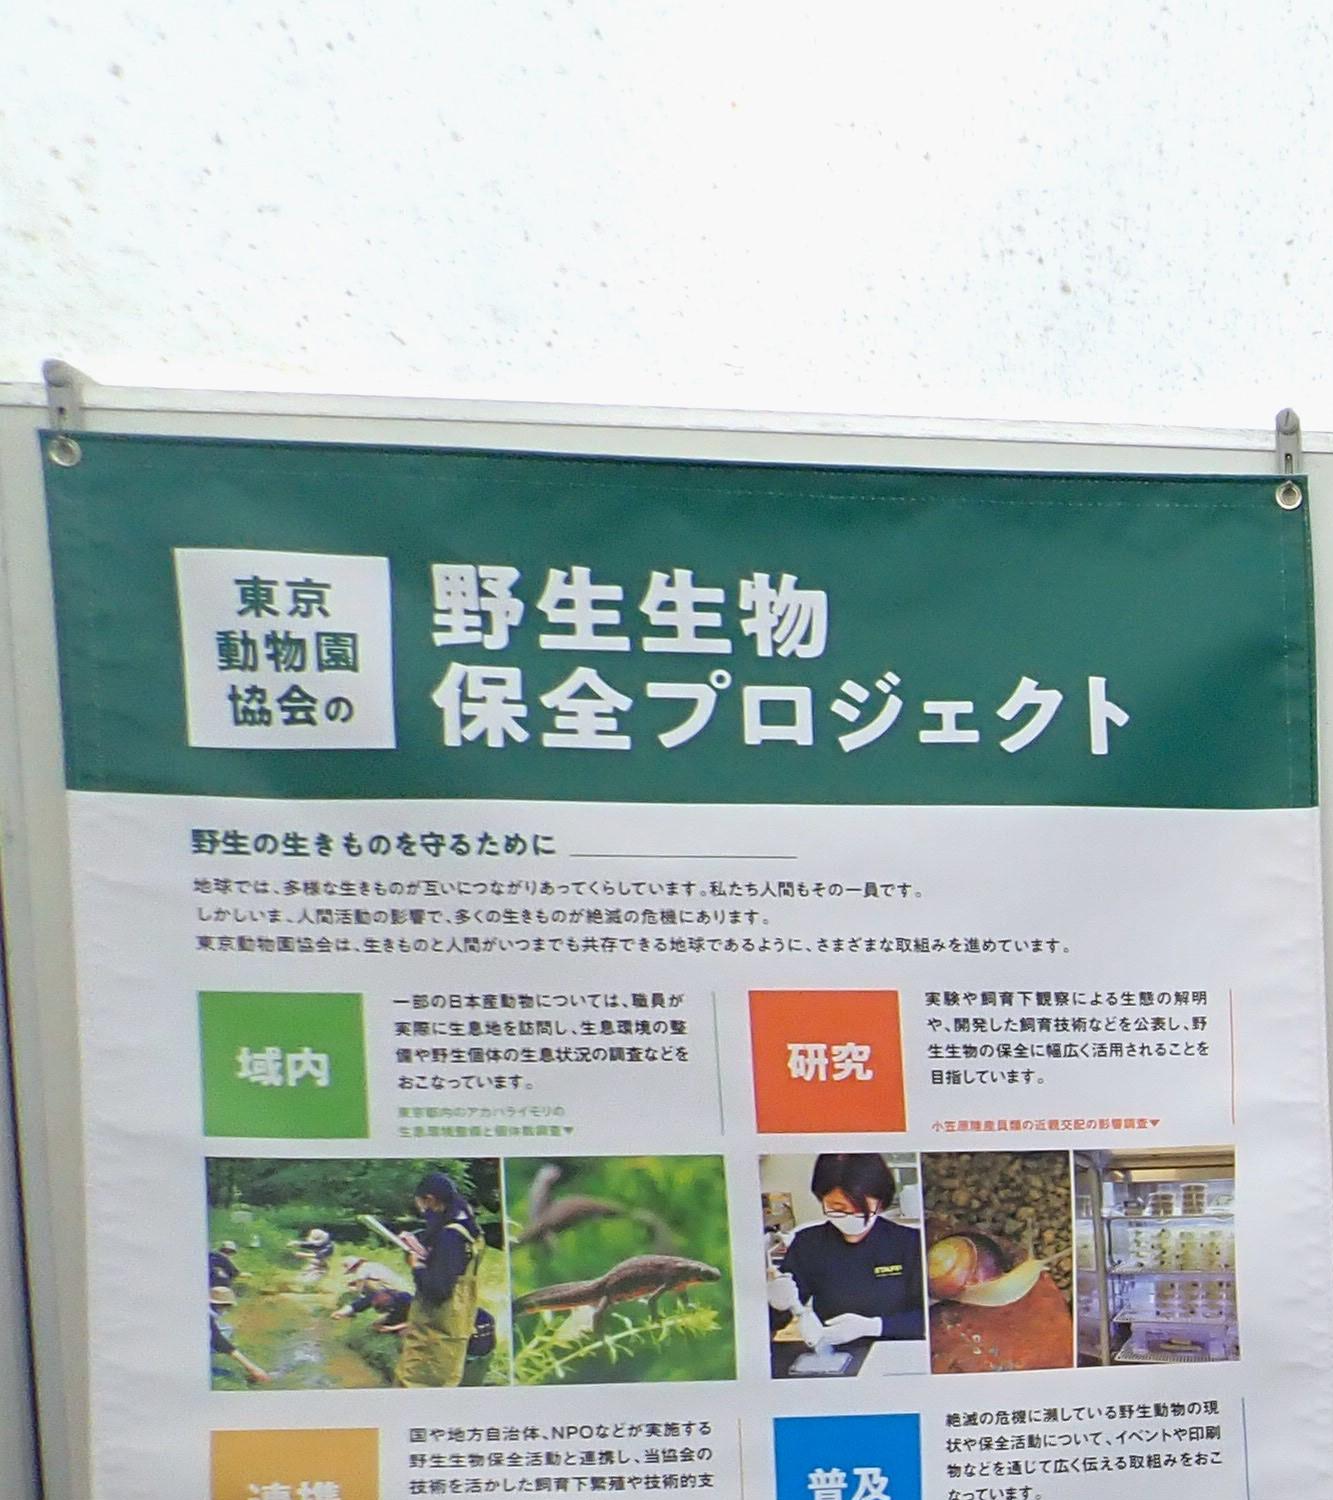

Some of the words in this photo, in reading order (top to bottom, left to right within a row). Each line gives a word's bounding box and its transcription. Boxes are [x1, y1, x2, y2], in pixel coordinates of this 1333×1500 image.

[236, 573, 330, 621] 東京
[430, 561, 829, 660] 野生生物
[215, 628, 360, 676] 動物園
[226, 682, 356, 729] 協会の
[432, 664, 1135, 757] 保全プロジェクト
[191, 828, 557, 858] 野生の生きものを守るために
[393, 992, 685, 1011] 一部の日本産動物については、職員が
[924, 990, 1209, 1008] 実験や飼育下観察による生態の解明
[395, 1019, 688, 1038] 実際に生息地を訪問し、生息環境の整
[926, 1016, 1209, 1034] や、開発した飼育技術などを公表し、野
[396, 1046, 689, 1065] 備や野生個体の生息状況の調査などを
[786, 1042, 873, 1083] 研究
[928, 1041, 1210, 1059] 生生物の保全に幅広く活用されることを
[235, 1046, 331, 1088] 域内
[930, 1067, 1046, 1086] 目指しています。
[397, 1073, 535, 1091] おこなっています。
[945, 1399, 1220, 1429] 絶滅の危機に瀕している野生動物の現
[409, 1420, 713, 1444] 国や地方自治体、NPOなどが実施する
[945, 1425, 1222, 1454] 状や保全活動について、イベントや印刷
[409, 1447, 714, 1470] 野生生物保全活動と連携し、当協会の
[946, 1451, 1224, 1480] 物などを通じて広く伝える取組みをおこ
[409, 1473, 715, 1496] 技術を活かした飼育下繁殖や技術的支
